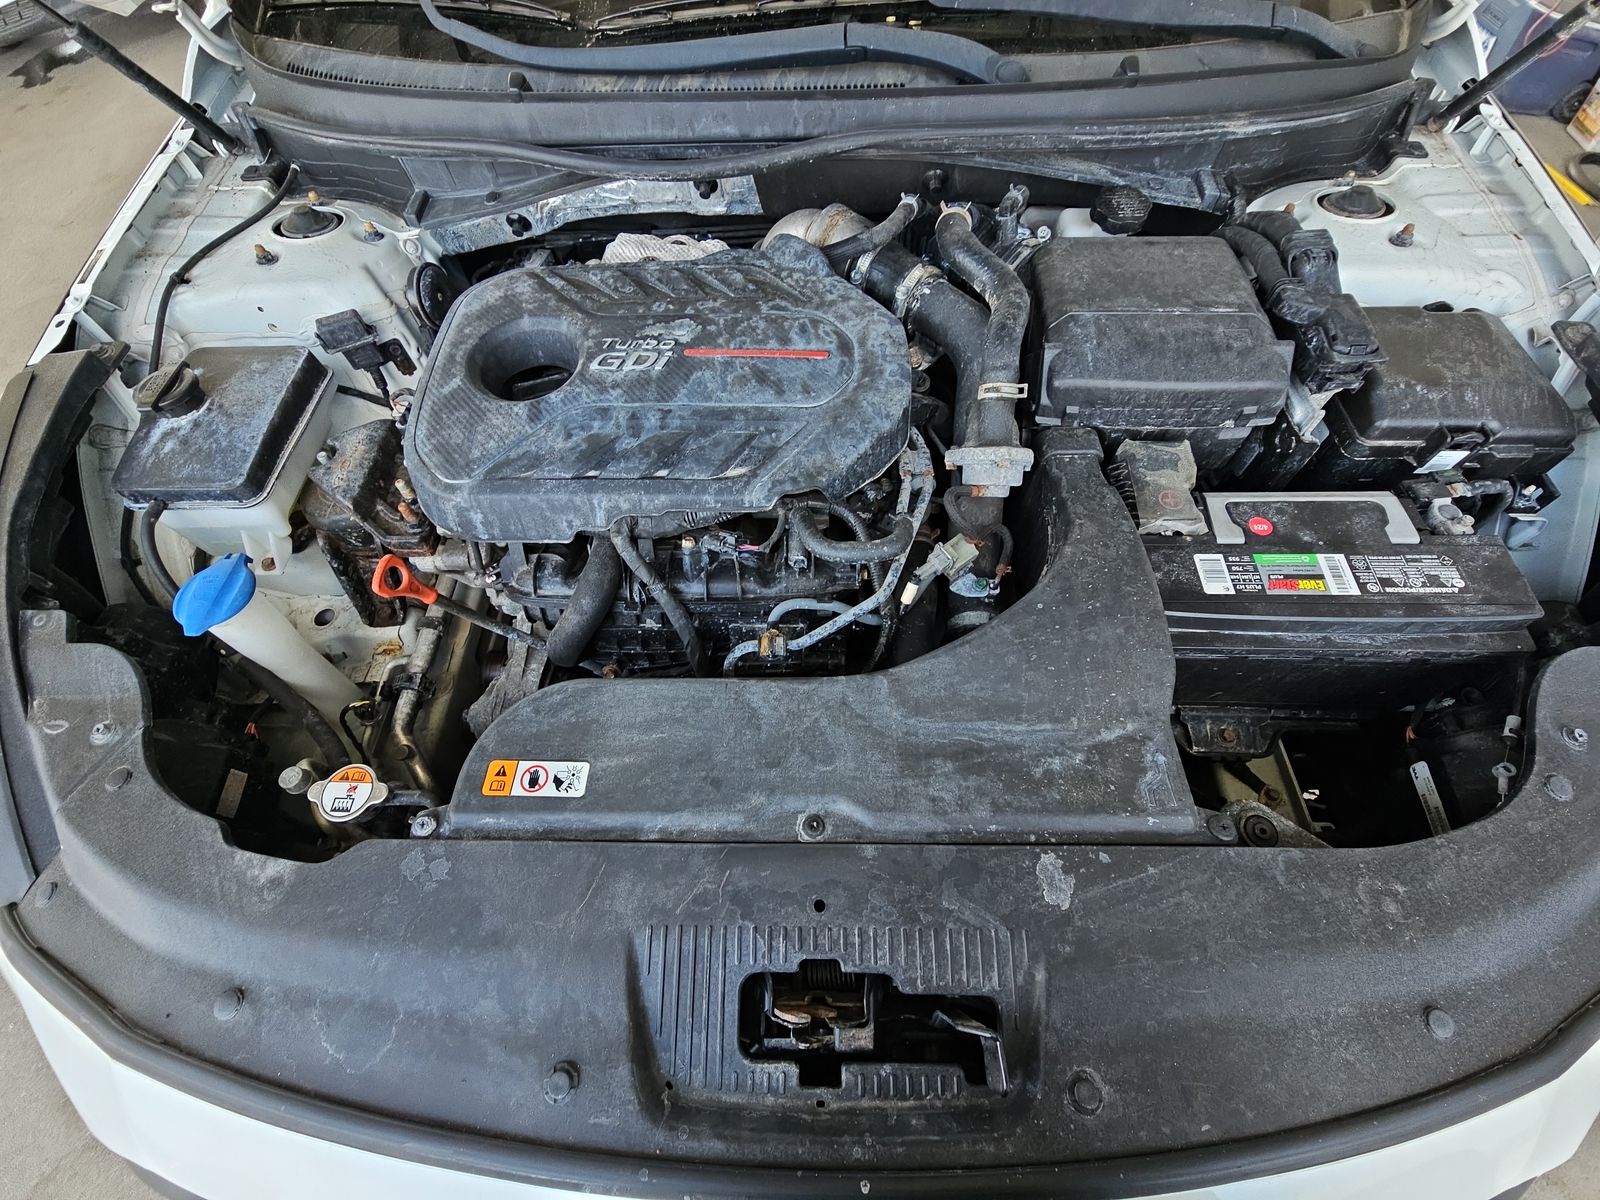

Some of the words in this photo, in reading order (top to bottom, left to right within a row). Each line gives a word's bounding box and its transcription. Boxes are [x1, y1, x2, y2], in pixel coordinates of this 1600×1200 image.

[601, 337, 675, 350] Turbo
[589, 350, 675, 371] GDi
[1267, 579, 1326, 591] EverStart
